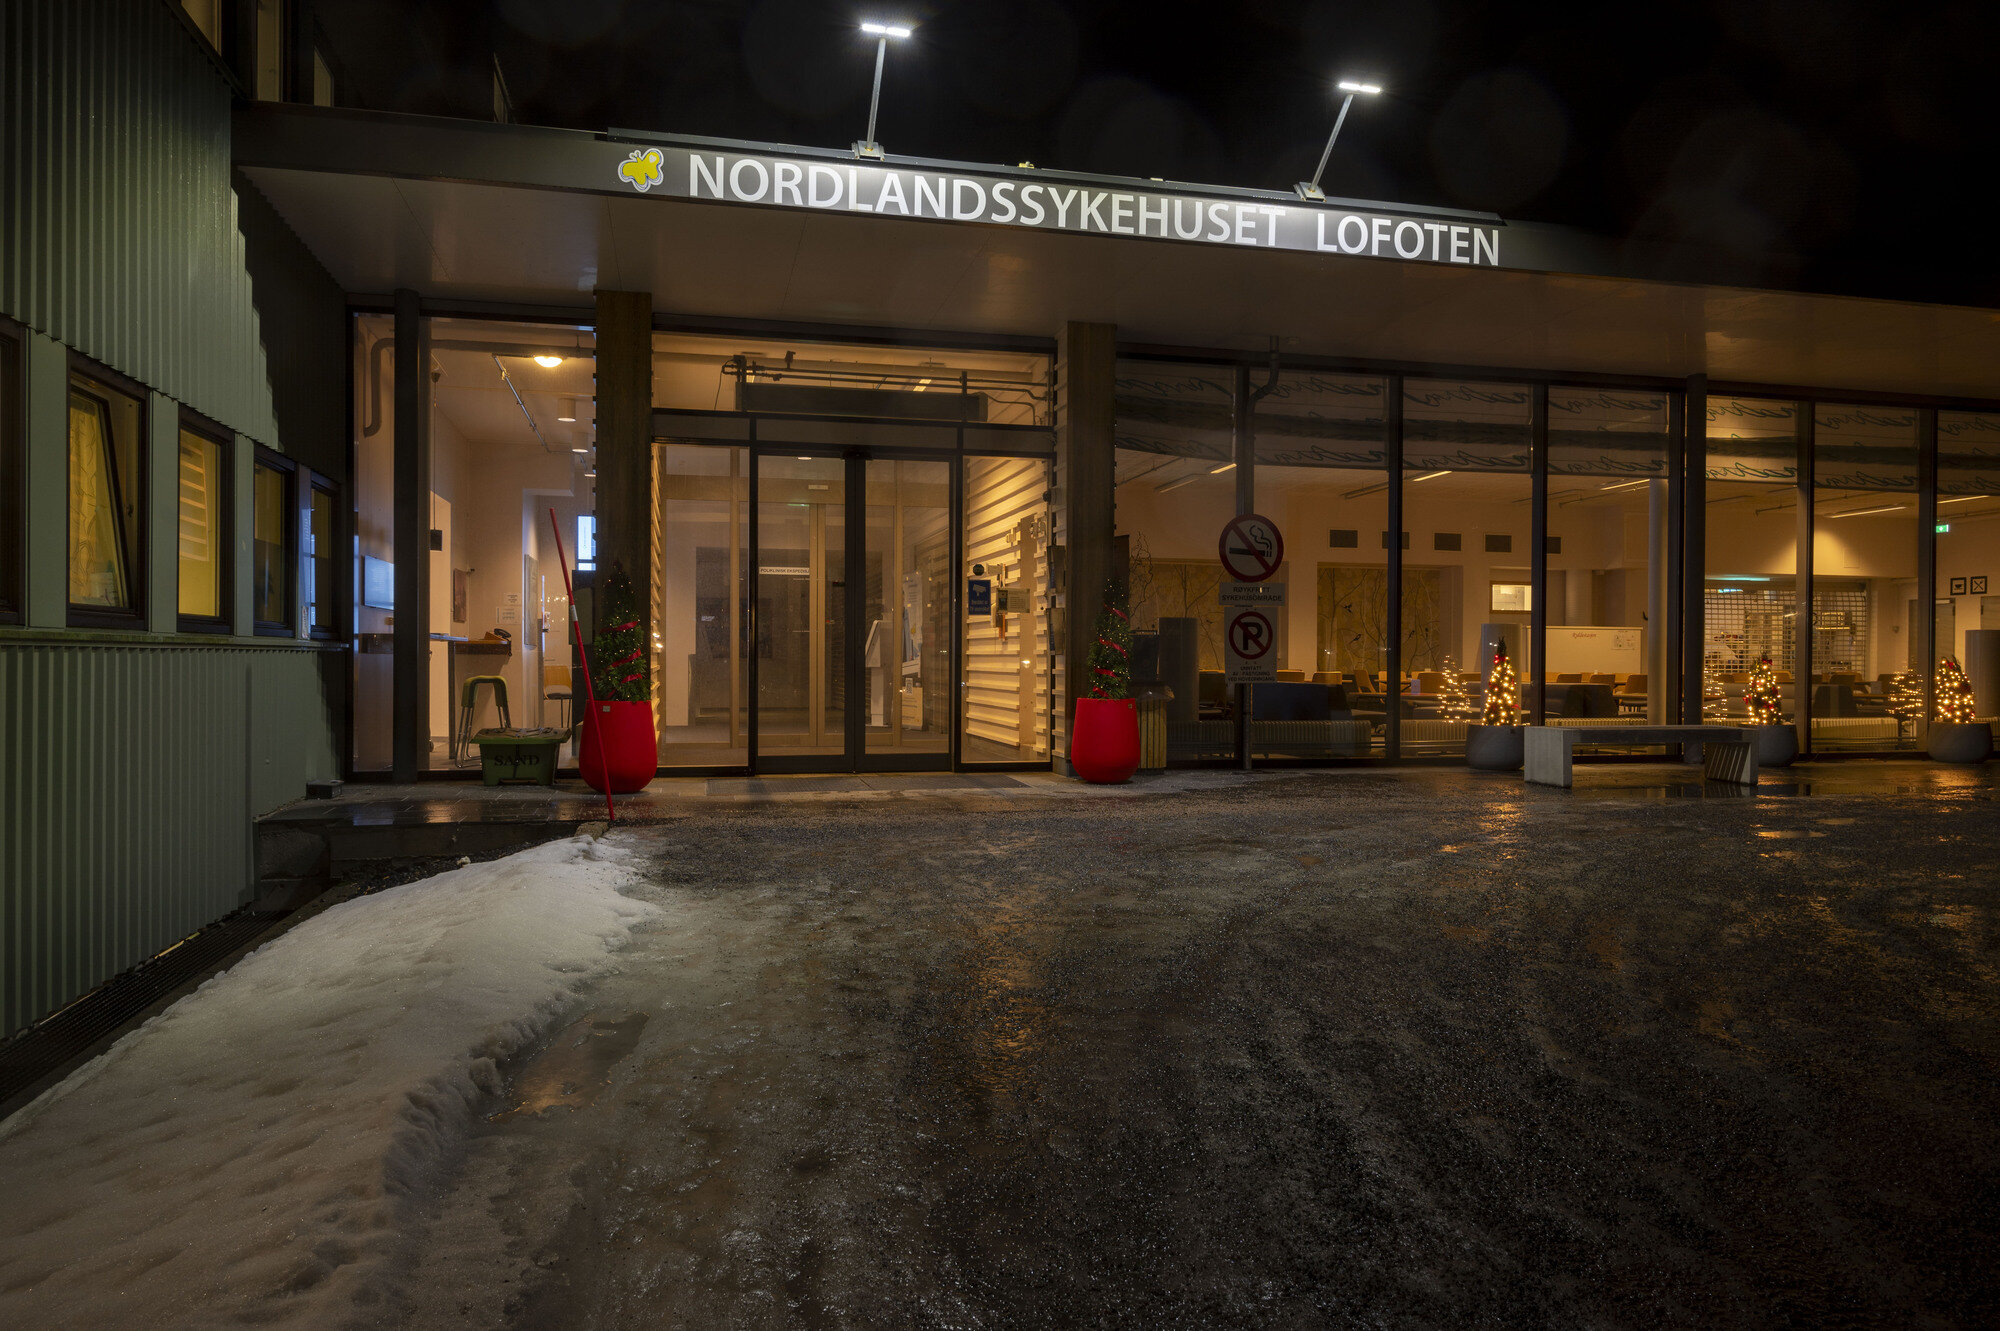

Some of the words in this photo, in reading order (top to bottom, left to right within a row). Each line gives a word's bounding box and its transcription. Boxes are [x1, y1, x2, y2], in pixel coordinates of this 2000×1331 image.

[689, 153, 1286, 247] NORDLANDSSYKEHUSET
[1316, 212, 1500, 266] LOFOTEN
[494, 754, 540, 767] SAND
